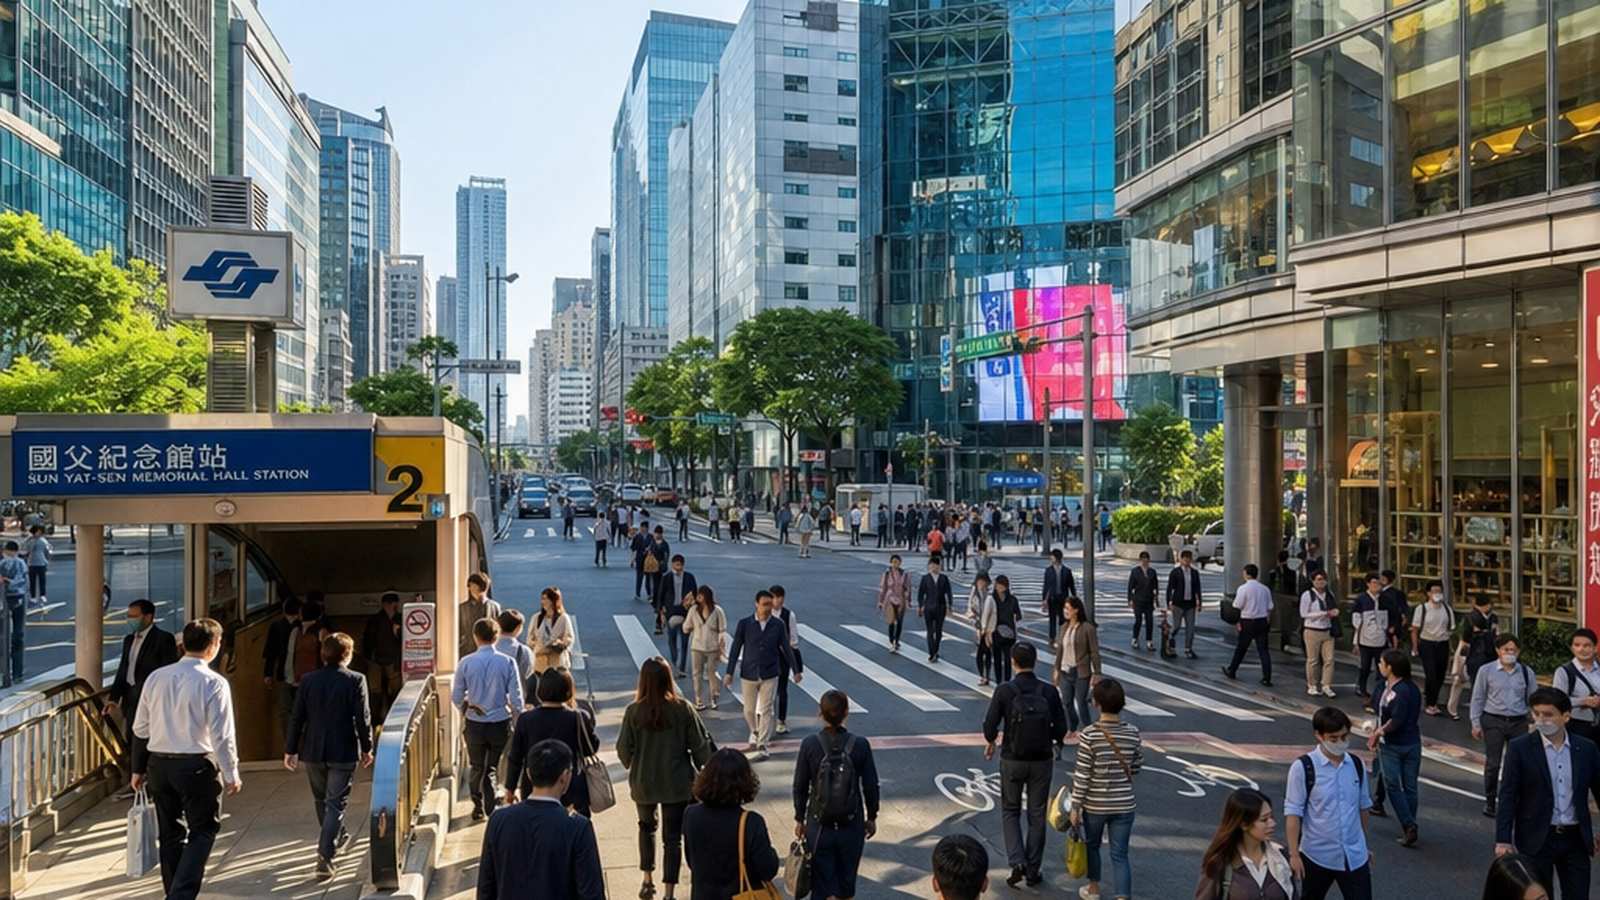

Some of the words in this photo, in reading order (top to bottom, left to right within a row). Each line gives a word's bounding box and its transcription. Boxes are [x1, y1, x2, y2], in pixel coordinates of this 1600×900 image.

[28, 443, 227, 471] 國父紀念館站
[28, 473, 58, 484] SUN
[64, 472, 126, 483] YAT-SEN
[132, 471, 208, 482] MEMORIAL
[213, 470, 249, 480] HALL
[254, 469, 309, 480] STATION
[387, 464, 423, 512] 2
